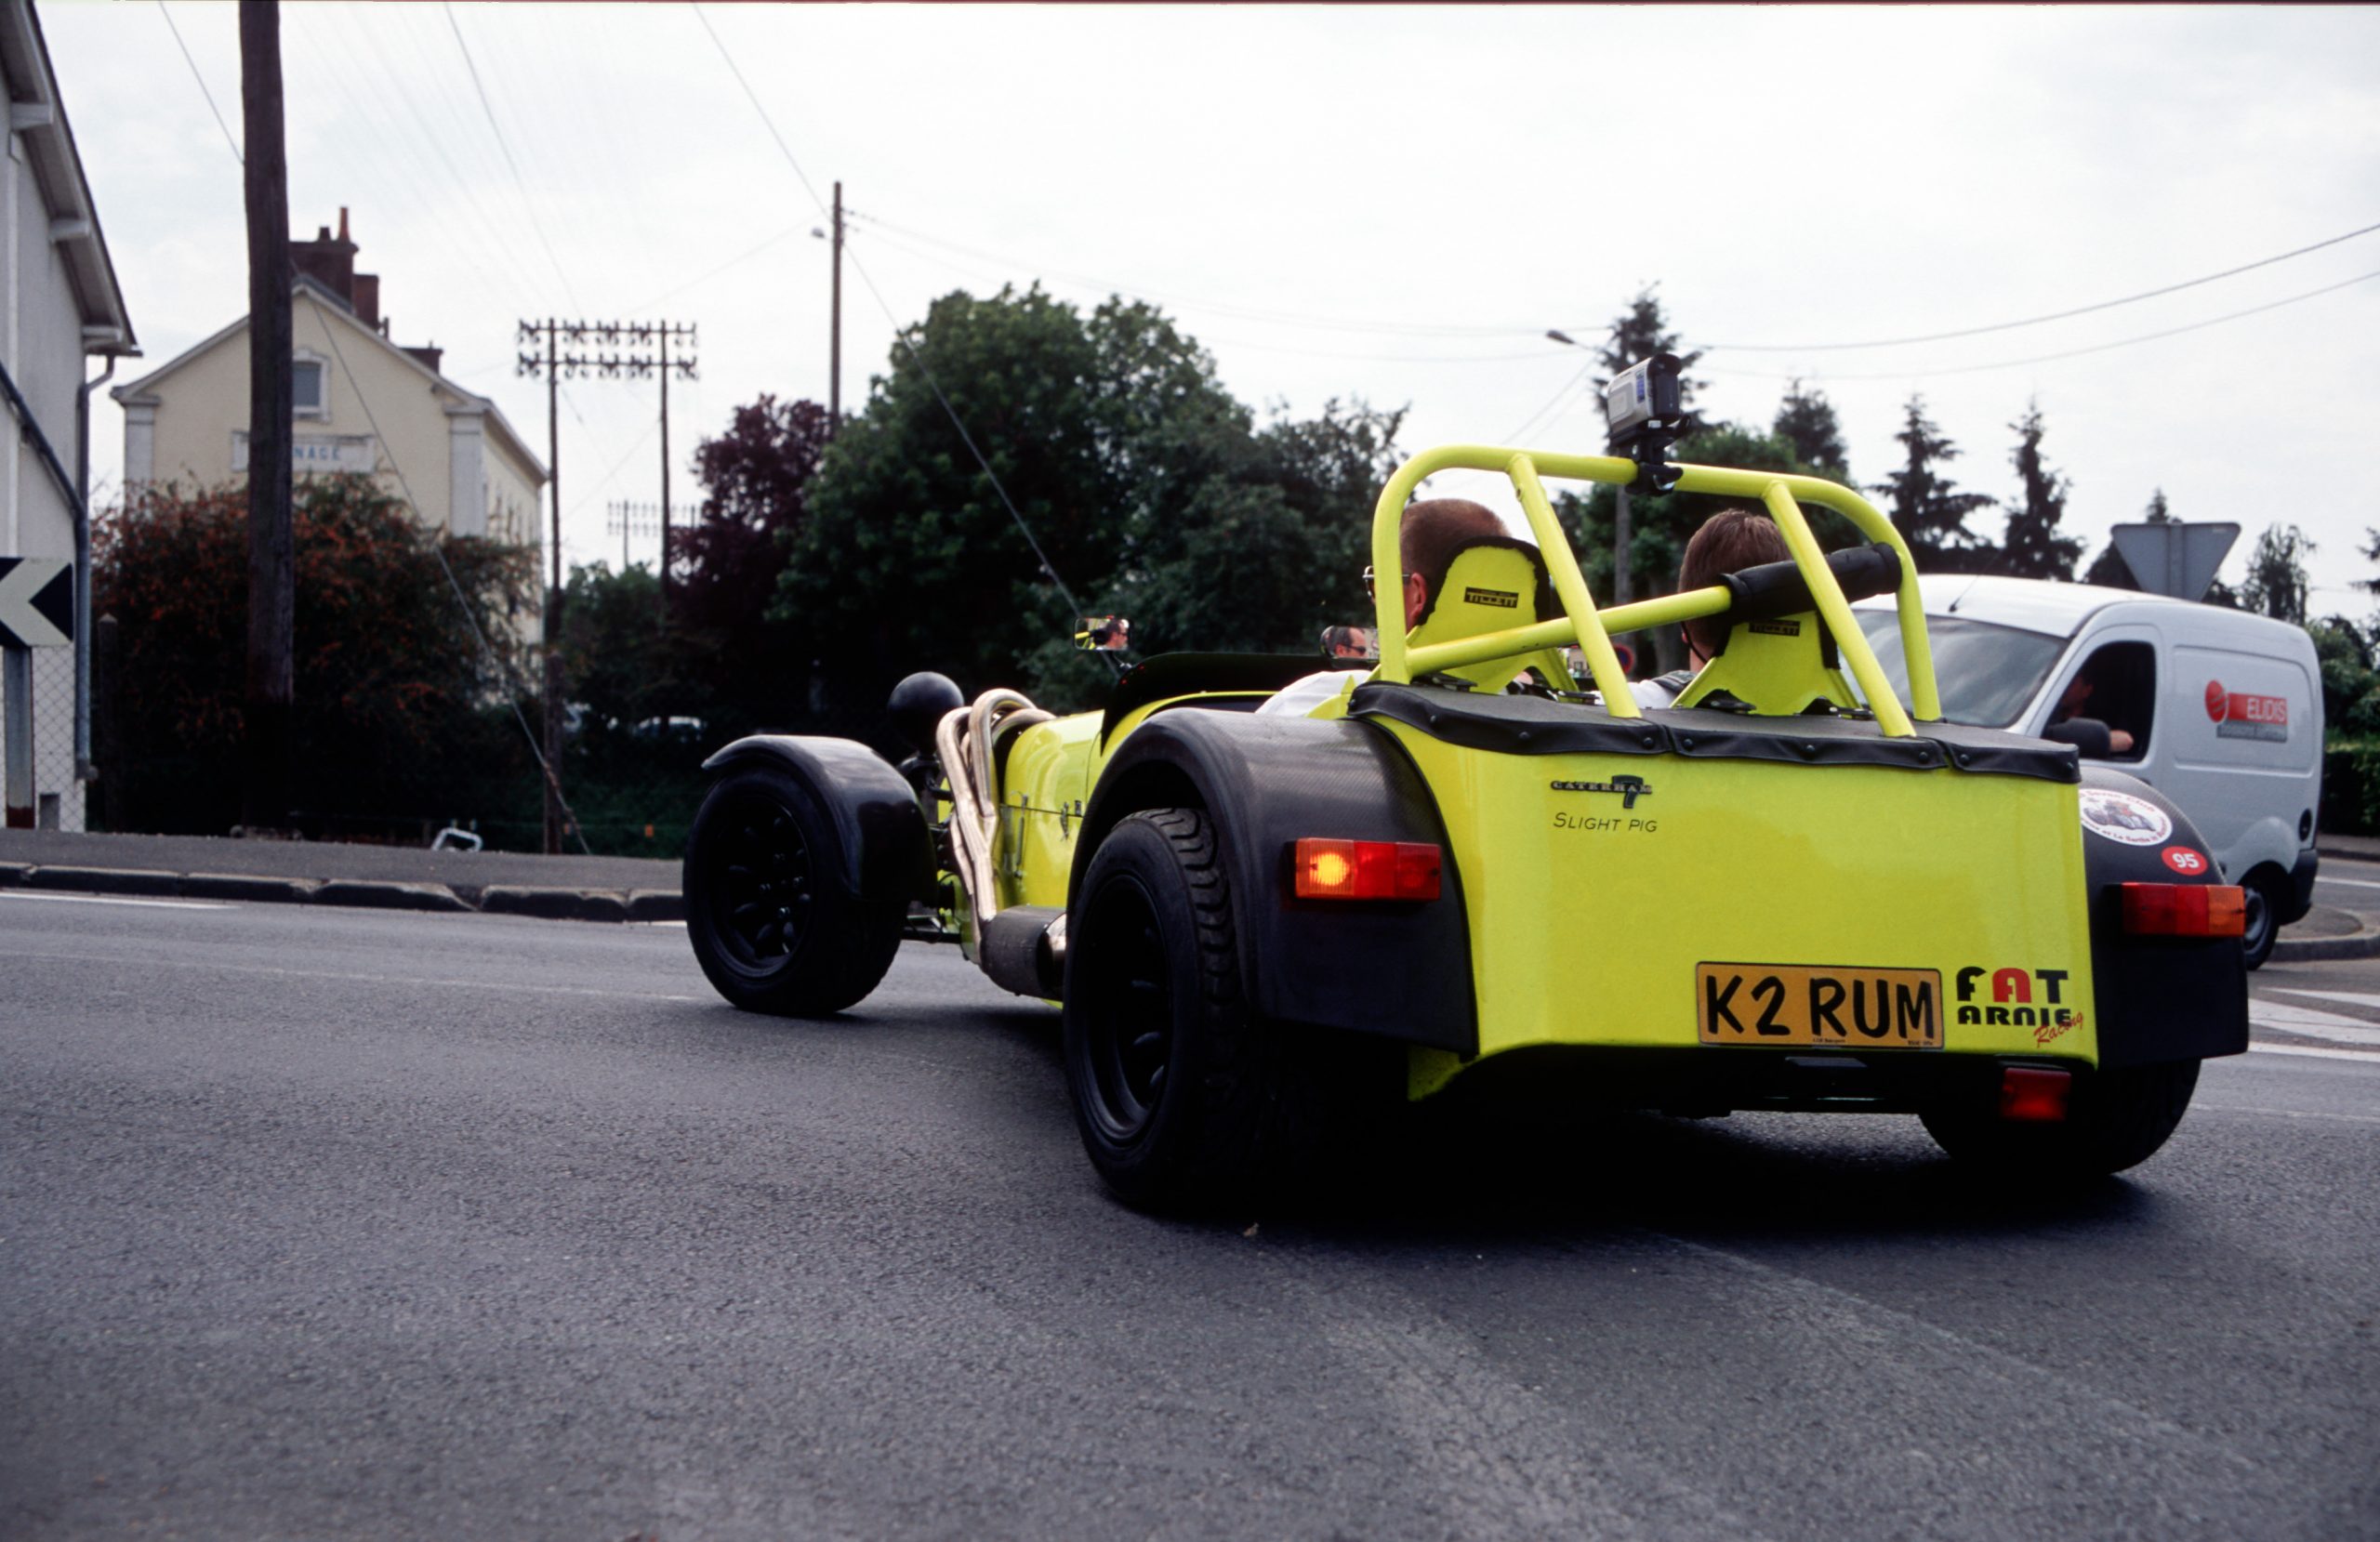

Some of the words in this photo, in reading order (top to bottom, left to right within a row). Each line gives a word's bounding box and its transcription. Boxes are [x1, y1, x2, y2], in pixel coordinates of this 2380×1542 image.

[1552, 781, 1652, 794] CATERHAM
[1553, 811, 1621, 832] SLIGHT
[1628, 819, 1658, 833] PIG
[2171, 852, 2200, 869] 95
[1956, 966, 2069, 1005] FAT
[1706, 974, 1791, 1036] K2
[1808, 977, 1935, 1040] RUM
[1957, 1005, 2072, 1027] ARNIE
[2033, 1010, 2083, 1049] Racing
